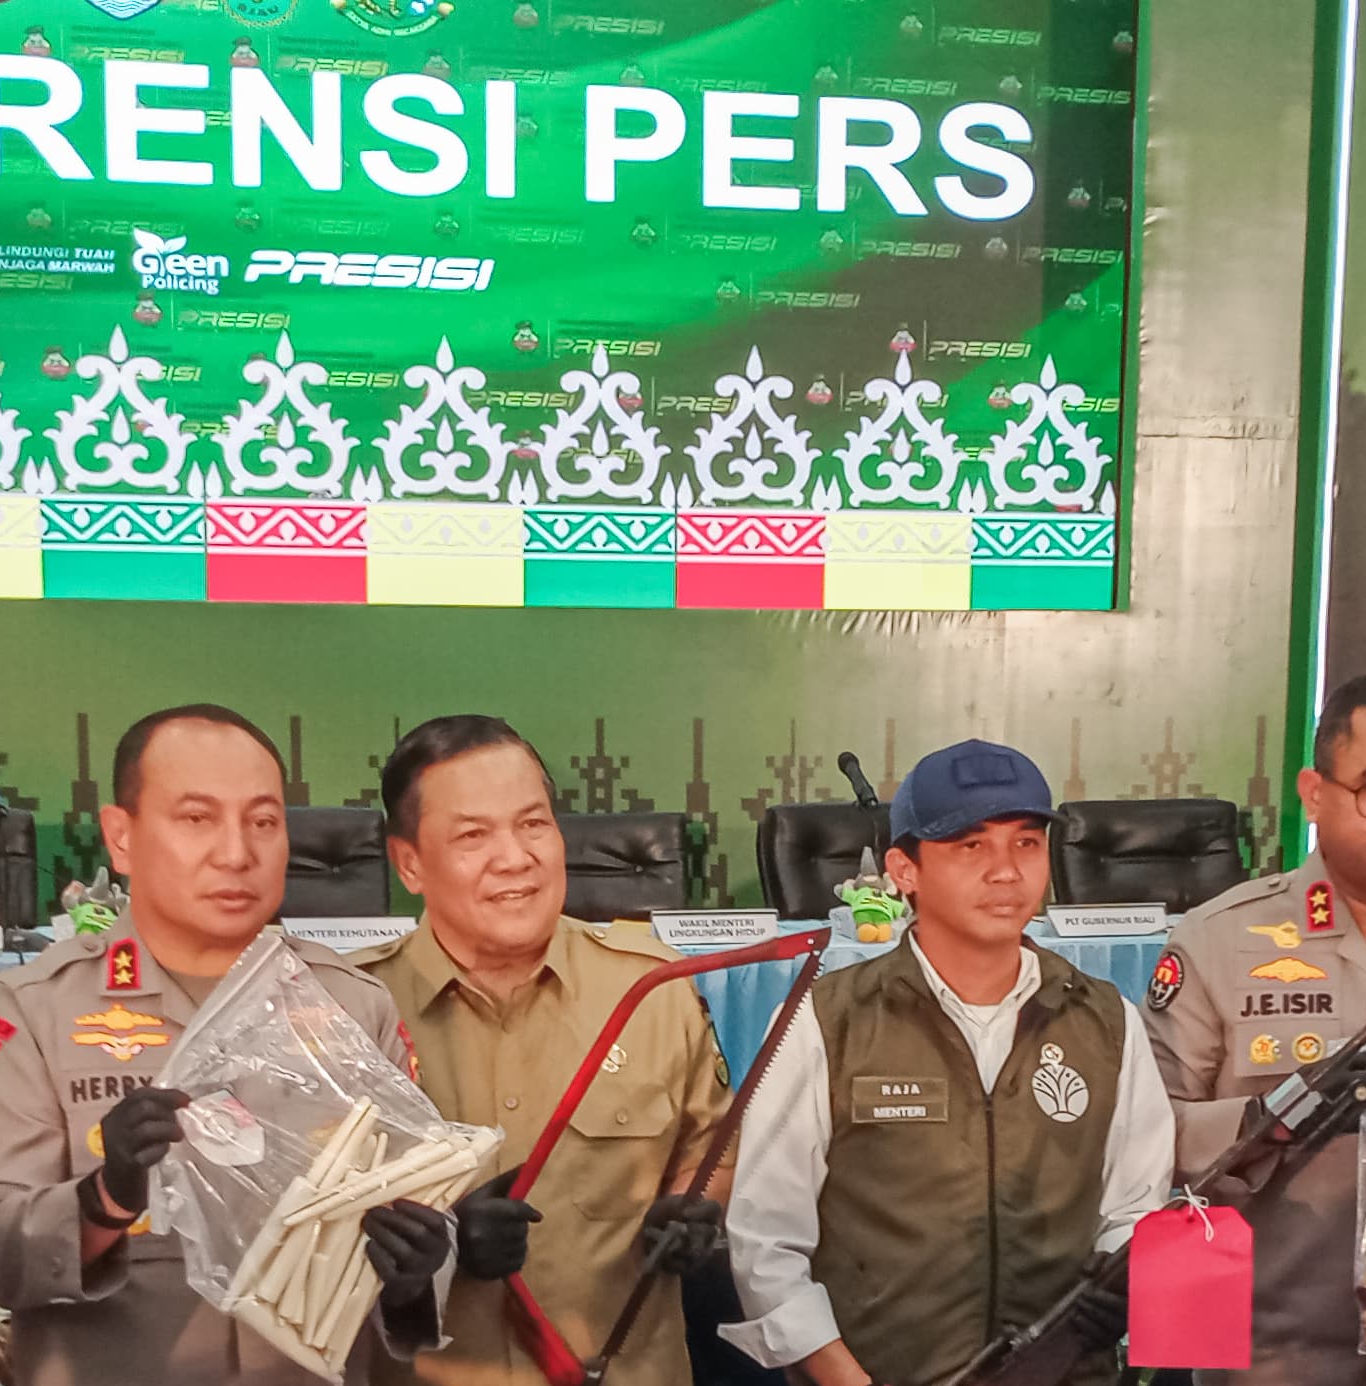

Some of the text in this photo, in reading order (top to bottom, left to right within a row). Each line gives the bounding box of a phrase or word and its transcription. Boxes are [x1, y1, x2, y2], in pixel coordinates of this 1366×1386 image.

[1036, 85, 1132, 105] PRESIS
[585, 84, 1036, 221] PERS
[73, 247, 116, 260] TUAH
[47, 259, 116, 274] MARWAH
[244, 249, 495, 291] PRESISI
[141, 274, 220, 296] Policing
[929, 340, 1032, 359] PRESISI
[711, 919, 755, 927] MENTERI
[668, 927, 766, 938] LINGKUNGAN HIDUP
[881, 1083, 920, 1096] RAJA
[873, 1105, 926, 1119] MENTERI
